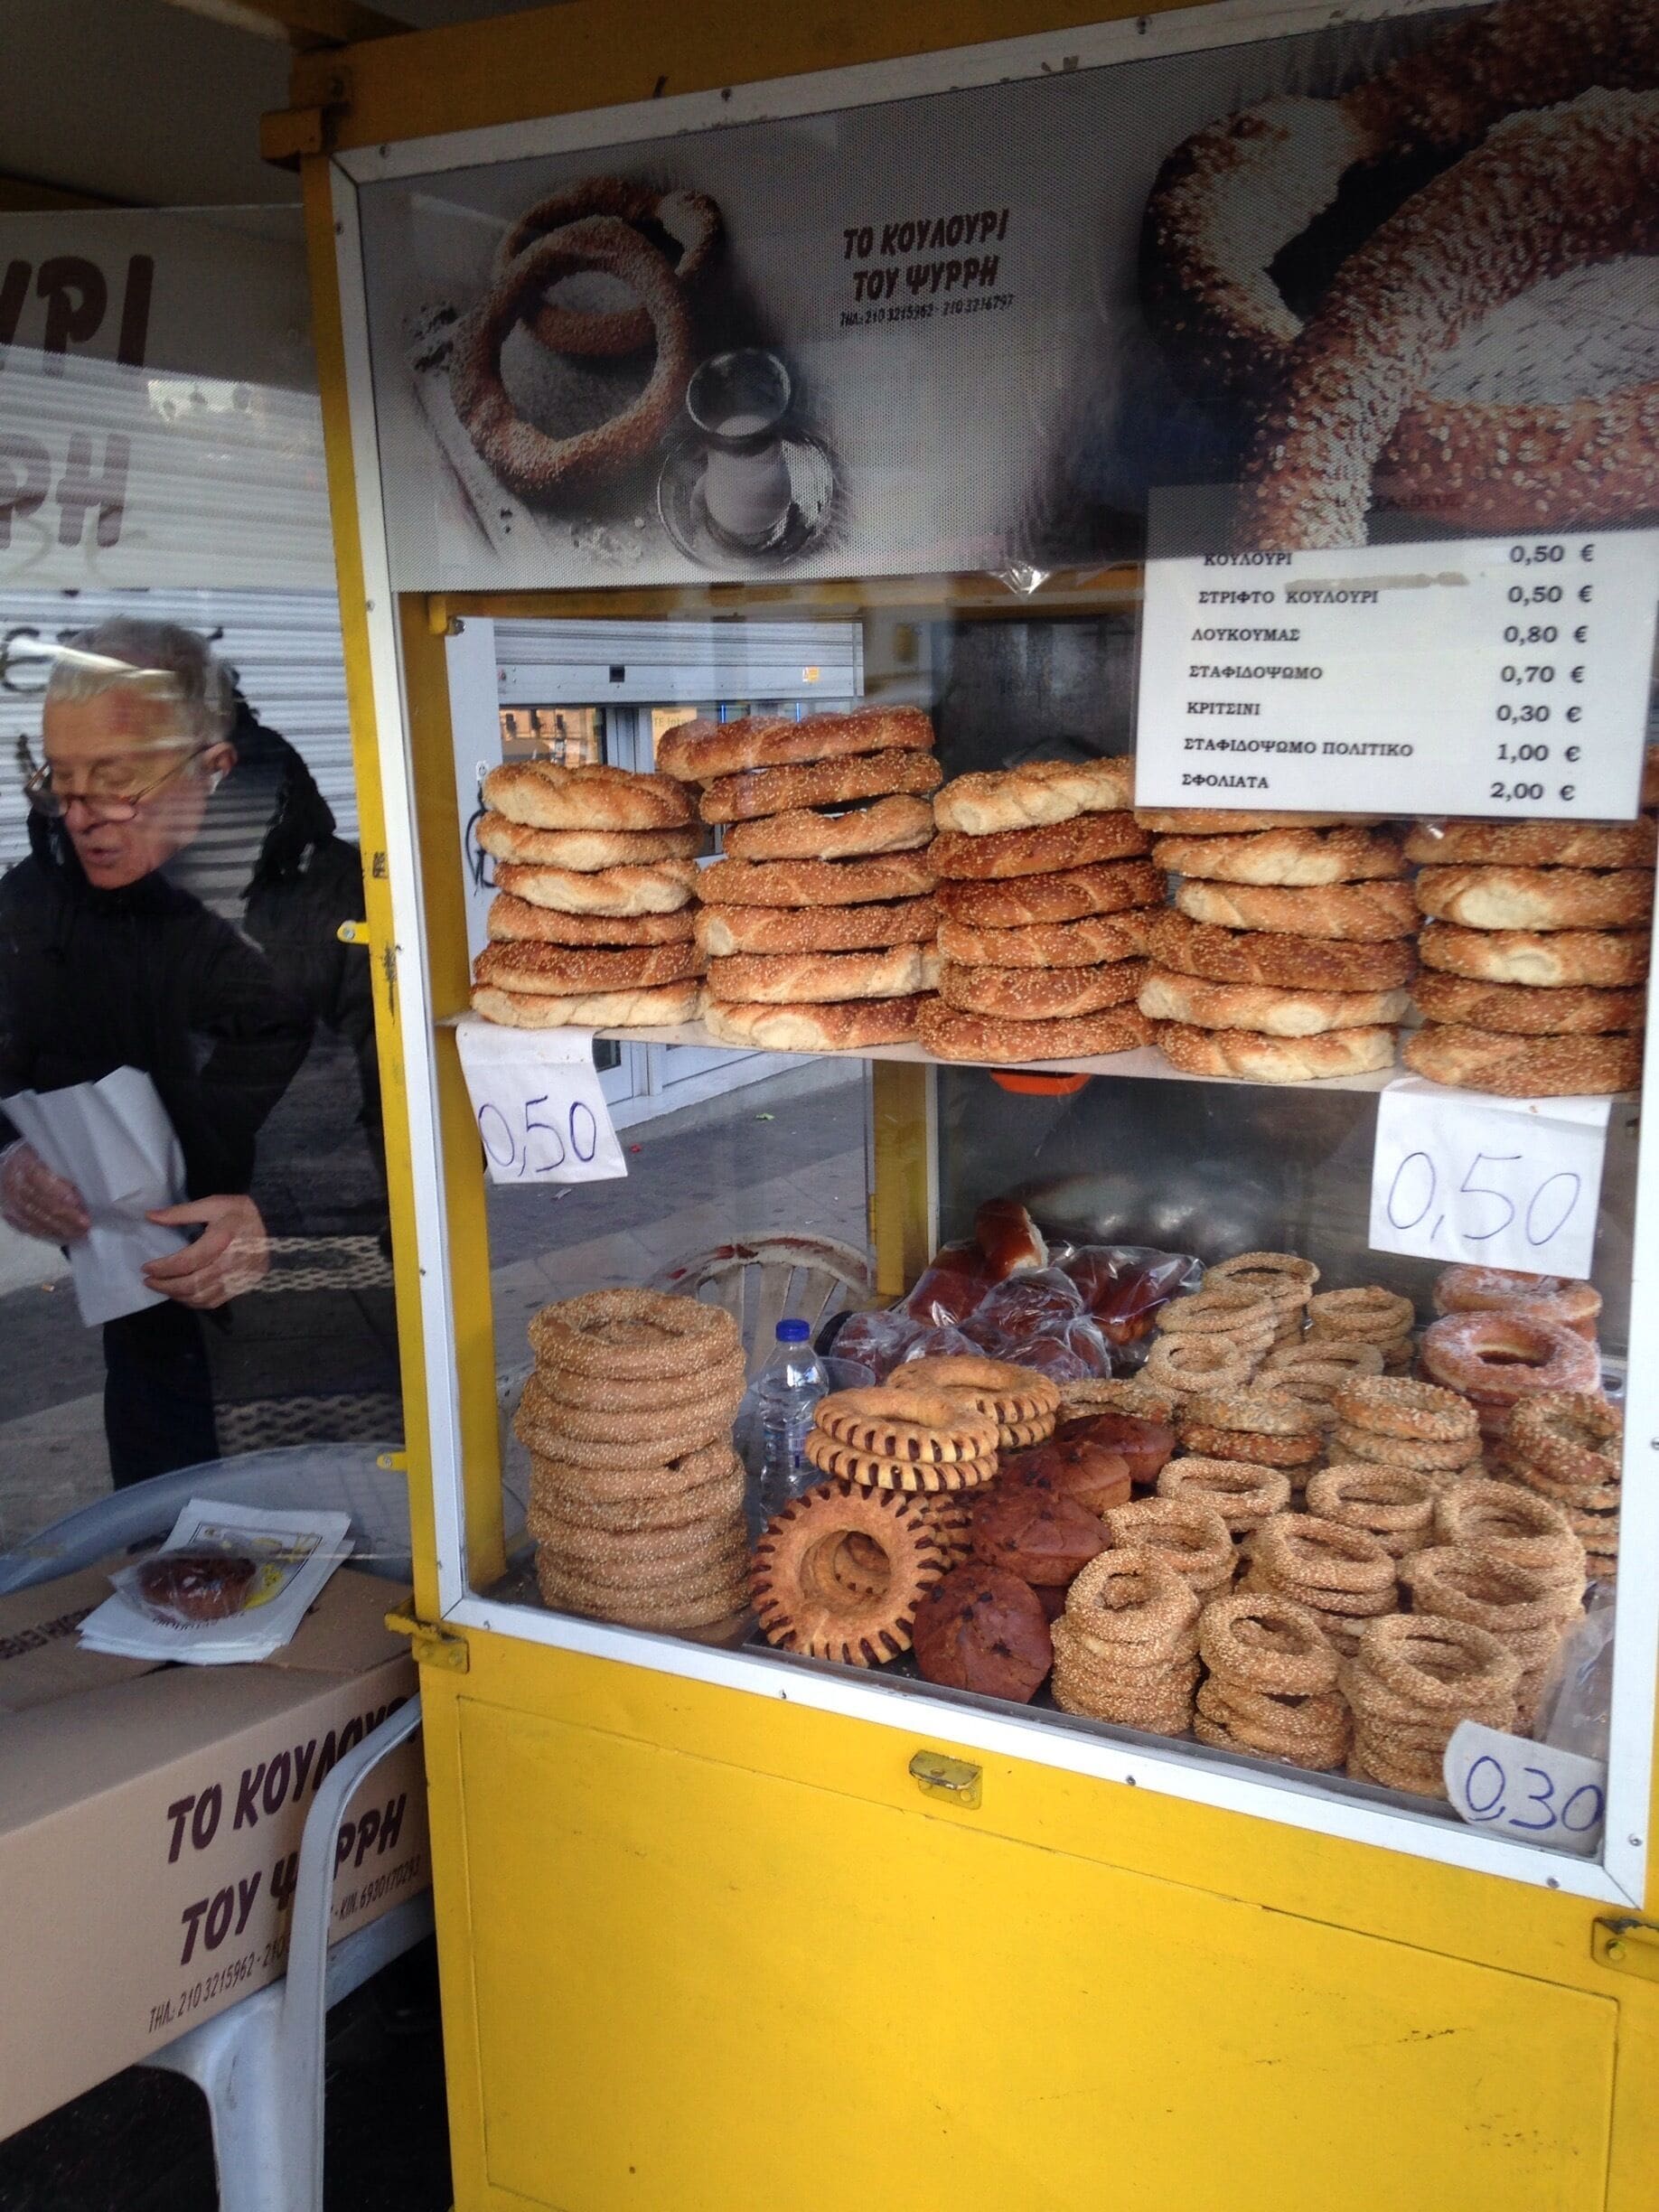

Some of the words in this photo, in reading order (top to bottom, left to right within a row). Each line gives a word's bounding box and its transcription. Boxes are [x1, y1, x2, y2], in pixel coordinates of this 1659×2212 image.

[843, 227, 874, 259] ΤΟ
[880, 209, 1009, 256] ΚΟΥΛΟΥΡΙ
[853, 267, 899, 302] ΤΟΥ
[906, 255, 999, 295] ΨΥΡΡΗ
[1204, 552, 1292, 566] ΚΟΥΛΟΥΡΙ
[1510, 545, 1565, 566] 0,50
[1580, 544, 1596, 562] €
[1198, 591, 1275, 604] ΣΤΡΙΦΤΟ
[1285, 590, 1378, 604] ΚΟΥΛΟΥΡΙ
[1508, 586, 1563, 606] 0,50
[1578, 586, 1593, 603] €
[1191, 629, 1300, 642] ΛΟΥΚΟΥΜΑΣ
[1504, 625, 1559, 646] 0,80
[1573, 625, 1589, 643] €
[1189, 665, 1323, 680] ΣΤΑΦΙΔΟΨΩΜΟ
[1501, 665, 1555, 686] 0,70
[1570, 666, 1585, 683] €
[1186, 702, 1261, 716] ΚΡΙΤΣΙΝΙ
[1496, 705, 1550, 725] 0,30
[1566, 706, 1582, 723] €
[1184, 738, 1317, 754] ΣΤΑΦΙΔΟΨΩΜΟ
[1322, 743, 1413, 756] ΠΟΛΙΤΙΚΟ
[1496, 744, 1550, 764] 1,00
[1565, 745, 1581, 763] €
[1182, 773, 1269, 789] ΣΦΟΛΙΑΤΑ
[1490, 782, 1543, 802] 2,00
[1560, 784, 1576, 801] €
[478, 1095, 597, 1177] 0,50
[1387, 1151, 1581, 1246] 0,50
[1466, 1756, 1605, 1832] 0,30
[167, 1784, 222, 1864] ΤΟ
[181, 1870, 262, 1965] ΤΟΥ
[270, 1793, 407, 1912] ΨΡΡΗ
